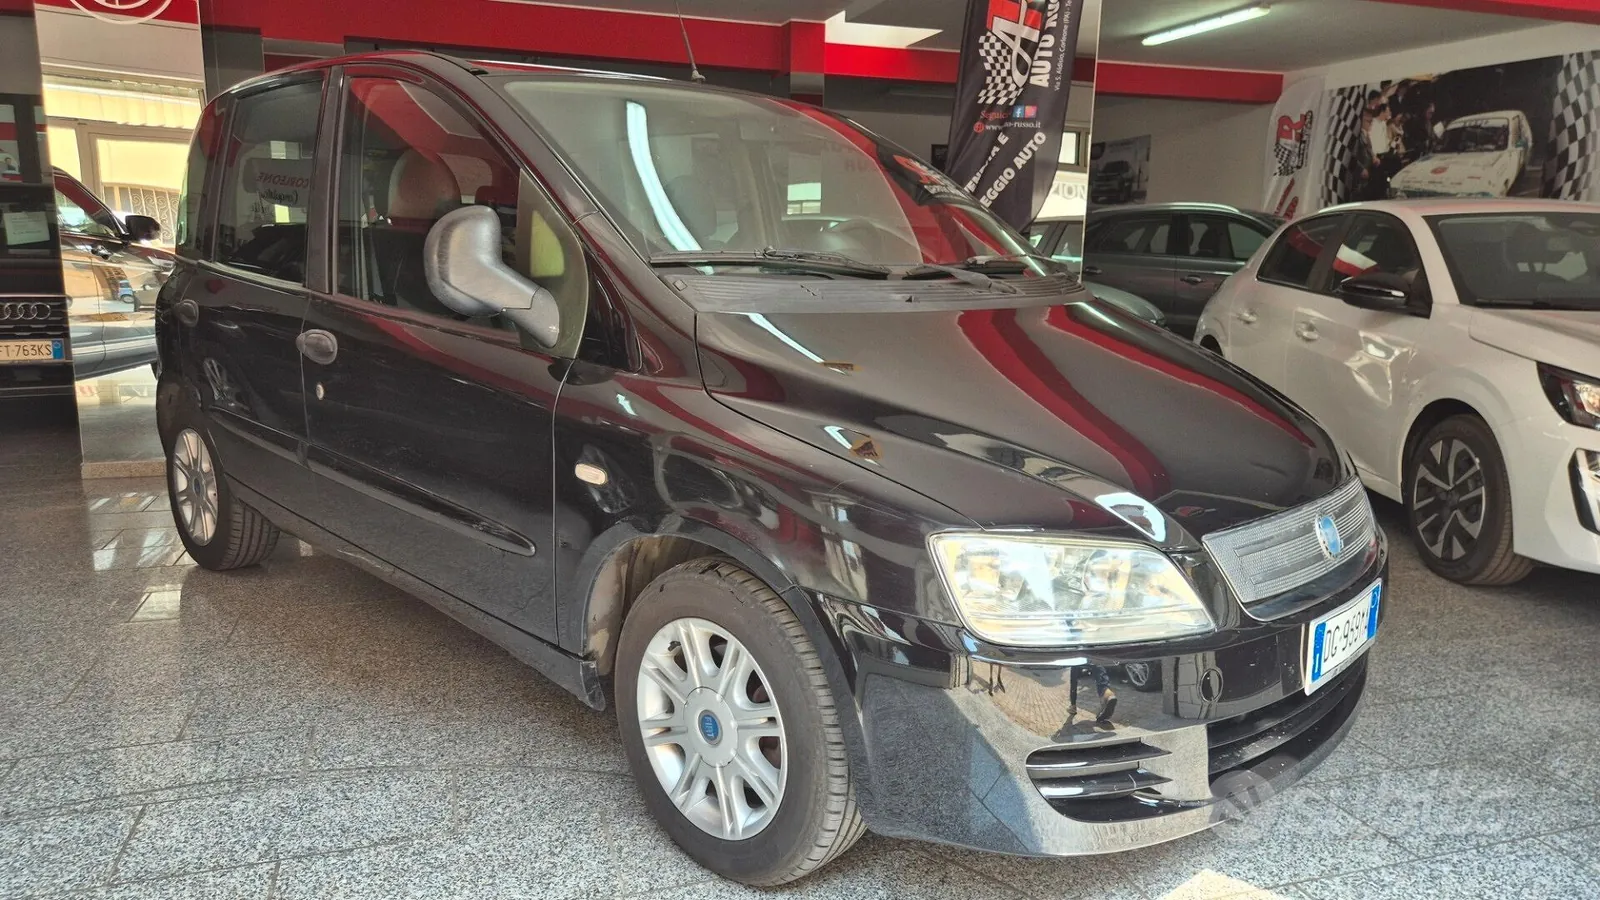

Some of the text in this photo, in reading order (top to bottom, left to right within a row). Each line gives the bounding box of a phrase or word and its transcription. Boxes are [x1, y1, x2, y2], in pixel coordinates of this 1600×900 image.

[1063, 11, 1071, 24] (PA)
[1059, 25, 1068, 53] Corleone
[1030, 34, 1055, 87] AUTO
[997, 132, 1009, 145] E
[980, 131, 1047, 209] EGGIO AUTO
